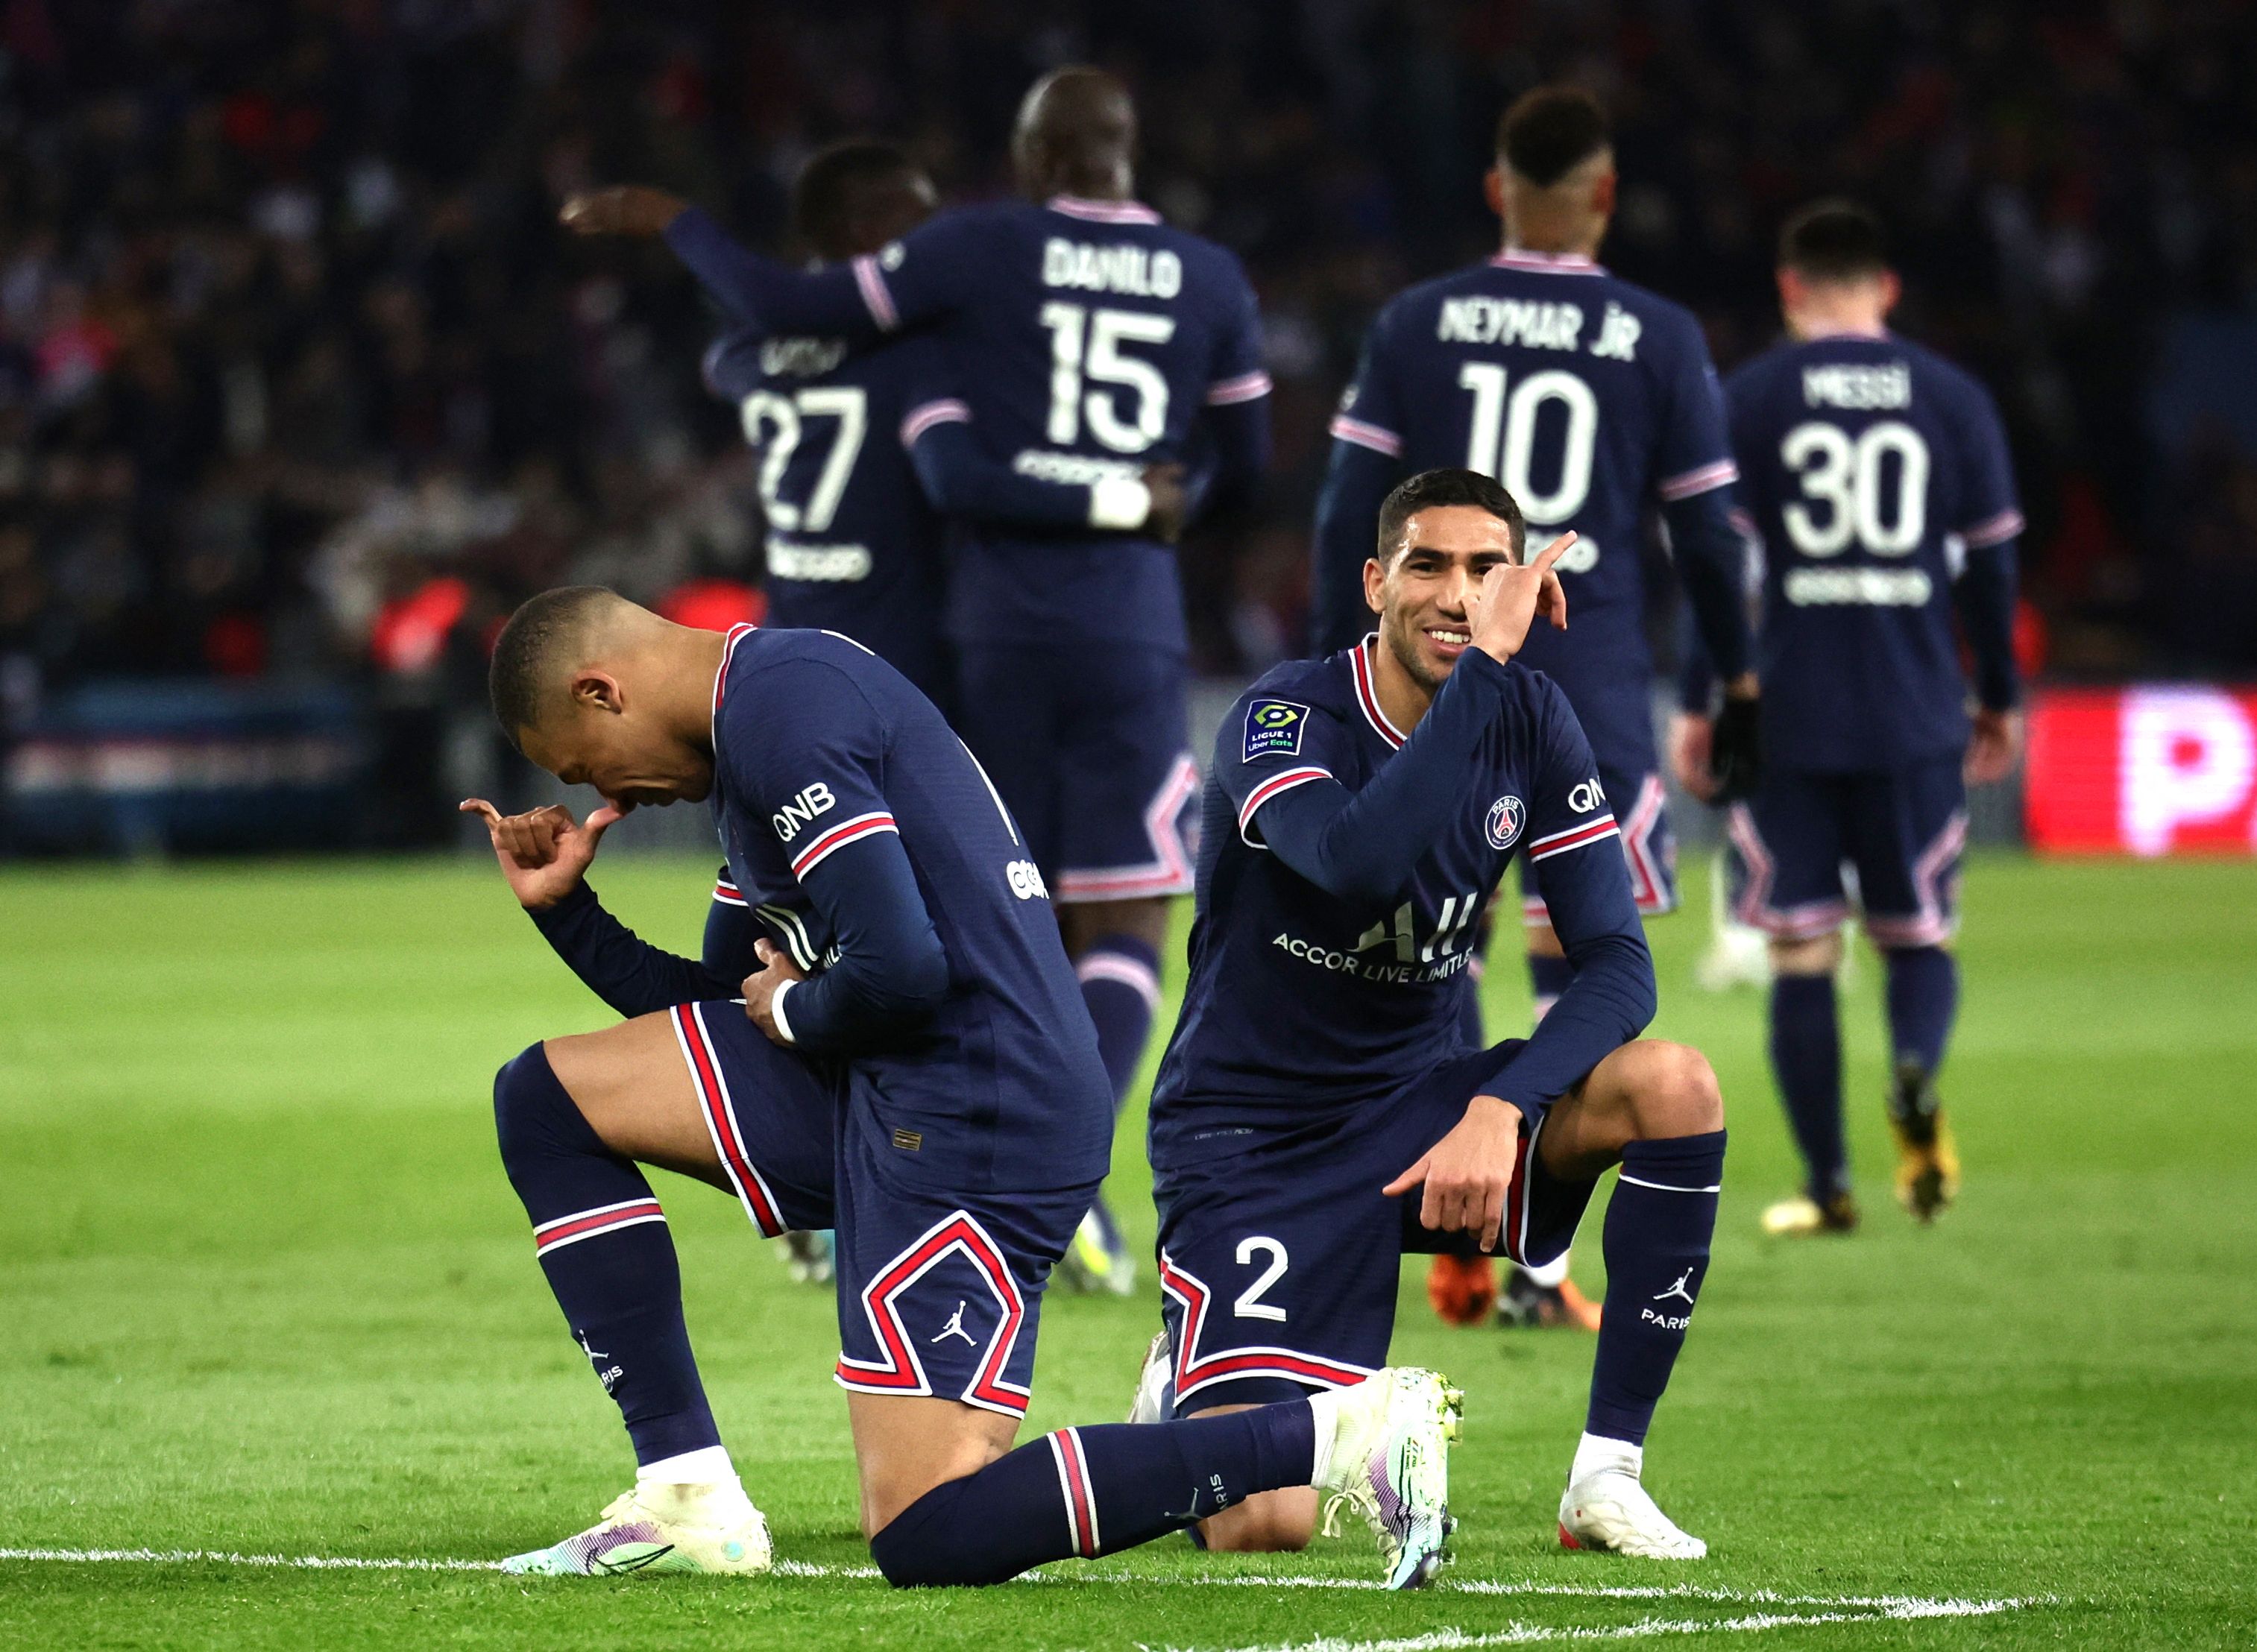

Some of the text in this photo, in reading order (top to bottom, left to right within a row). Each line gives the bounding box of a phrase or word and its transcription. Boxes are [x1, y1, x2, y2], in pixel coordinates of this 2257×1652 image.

[1045, 238, 1183, 298] DANILO
[1439, 297, 1583, 350] NEYMAR
[1041, 302, 1176, 453] 15
[742, 387, 868, 532] 27
[1458, 362, 1598, 524] 10
[1781, 422, 1928, 558] 30
[1248, 739, 1293, 751] Uber Eats
[1252, 731, 1284, 742] LIGUE
[1568, 778, 1606, 813] QN
[2119, 684, 2257, 856] P
[772, 782, 836, 842] QNB
[1492, 798, 1519, 815] PARIS
[1272, 933, 1475, 983] ACCOR LIVE LIMITLE
[1234, 1236, 1288, 1322] 2
[1641, 1308, 1691, 1330] PARIS
[1209, 1474, 1230, 1510] RIS
